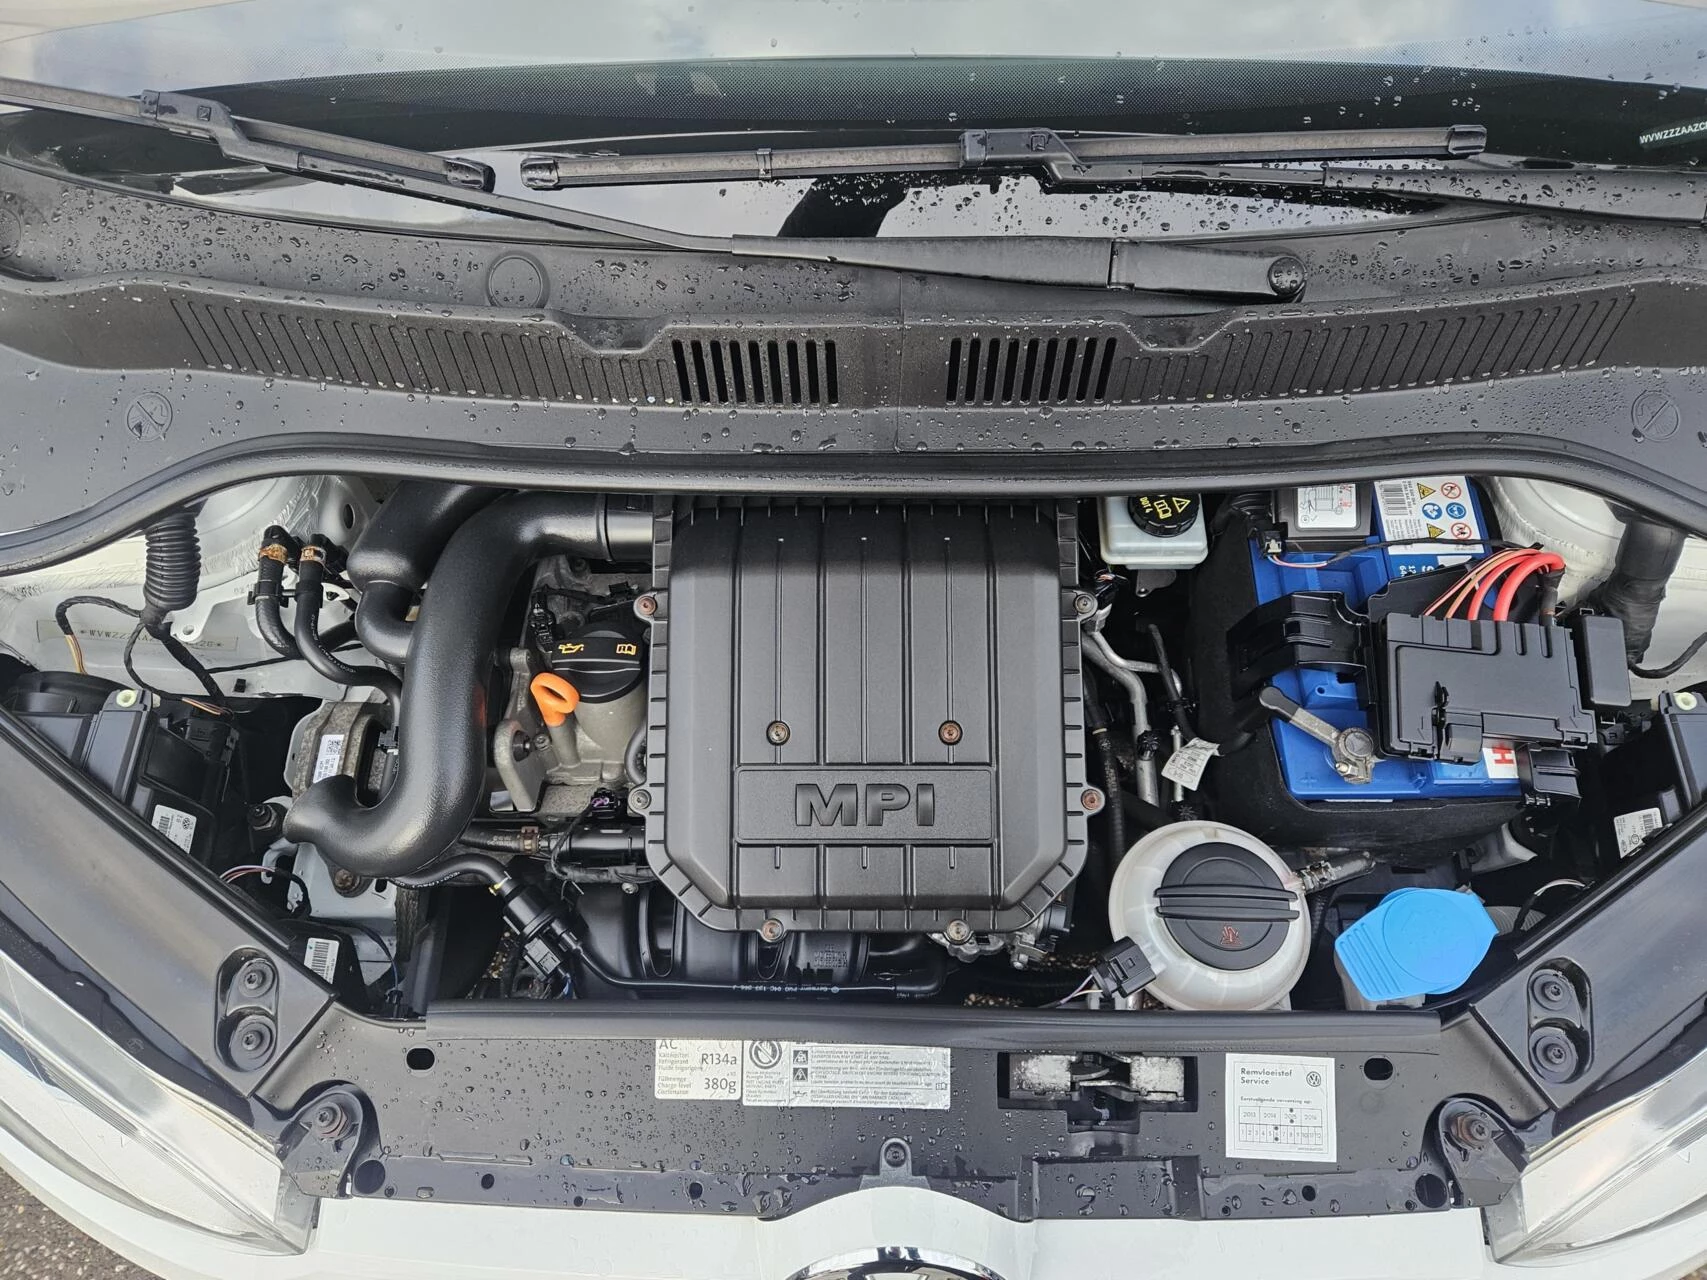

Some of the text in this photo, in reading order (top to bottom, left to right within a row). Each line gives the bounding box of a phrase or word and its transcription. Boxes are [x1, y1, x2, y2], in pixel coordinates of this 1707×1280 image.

[795, 783, 935, 826] MPI
[702, 1053, 737, 1065] R134a
[1240, 1067, 1292, 1077] Remvloeistof
[704, 1077, 737, 1094] 380g
[1240, 1076, 1270, 1085] Service
